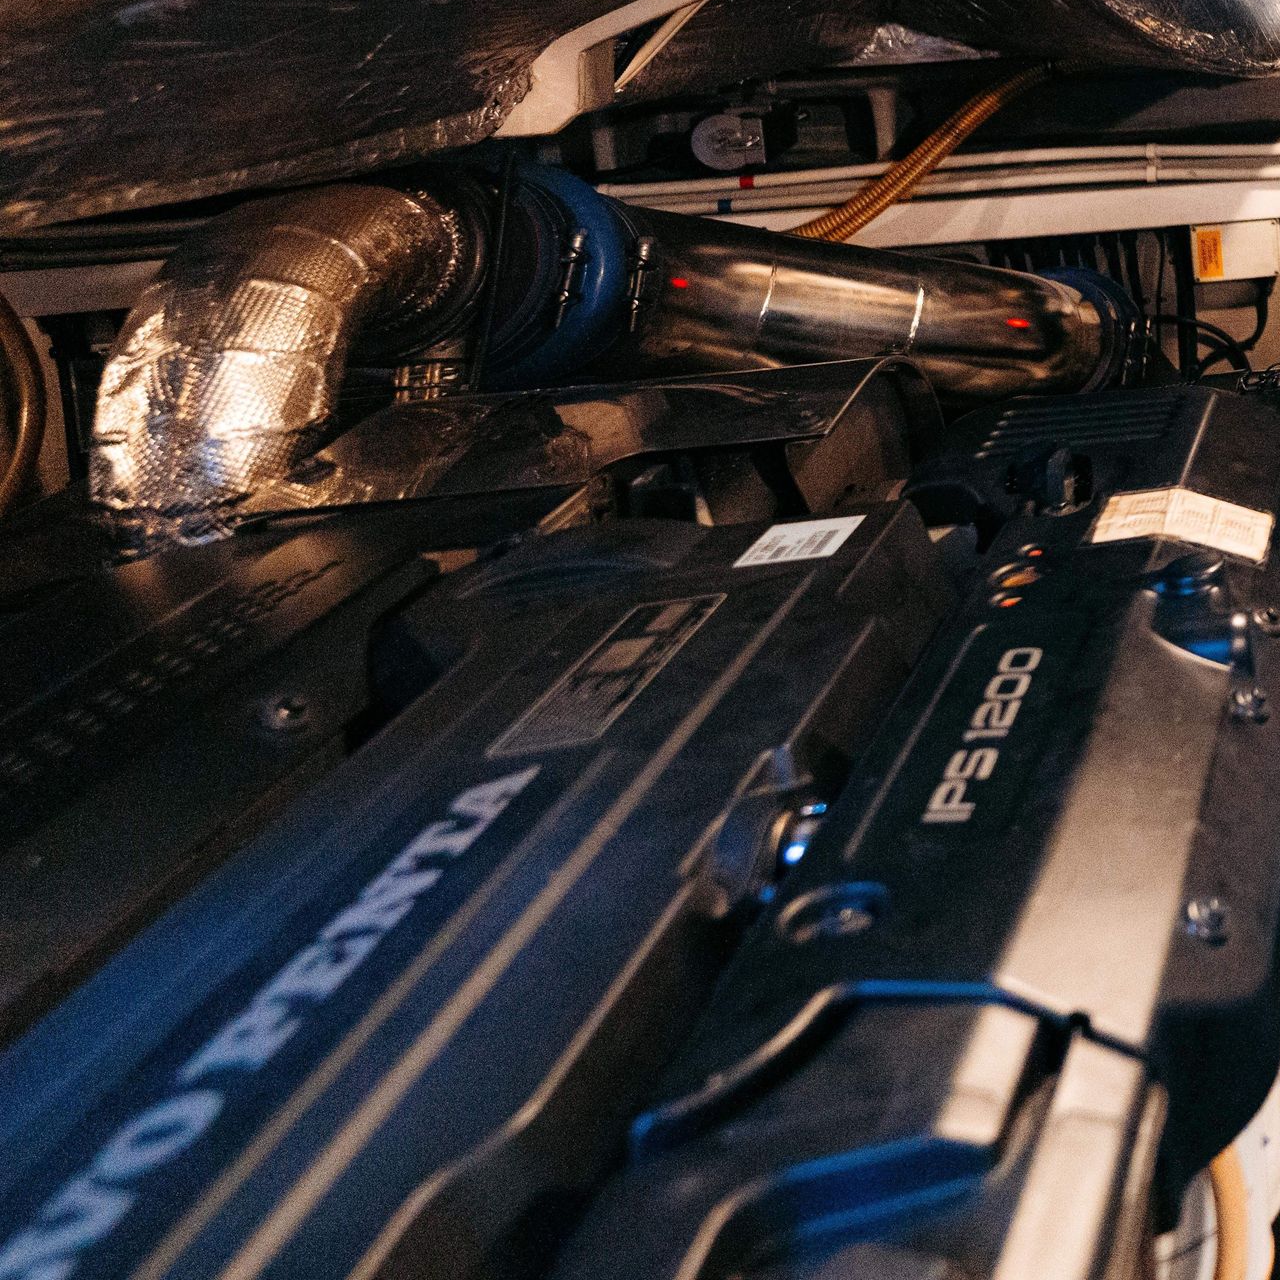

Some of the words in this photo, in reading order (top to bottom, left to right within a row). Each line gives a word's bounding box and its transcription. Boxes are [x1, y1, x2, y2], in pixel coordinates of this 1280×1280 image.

[921, 747, 1000, 825] IPS
[961, 646, 1044, 743] 1200
[178, 763, 542, 1082] PENTA
